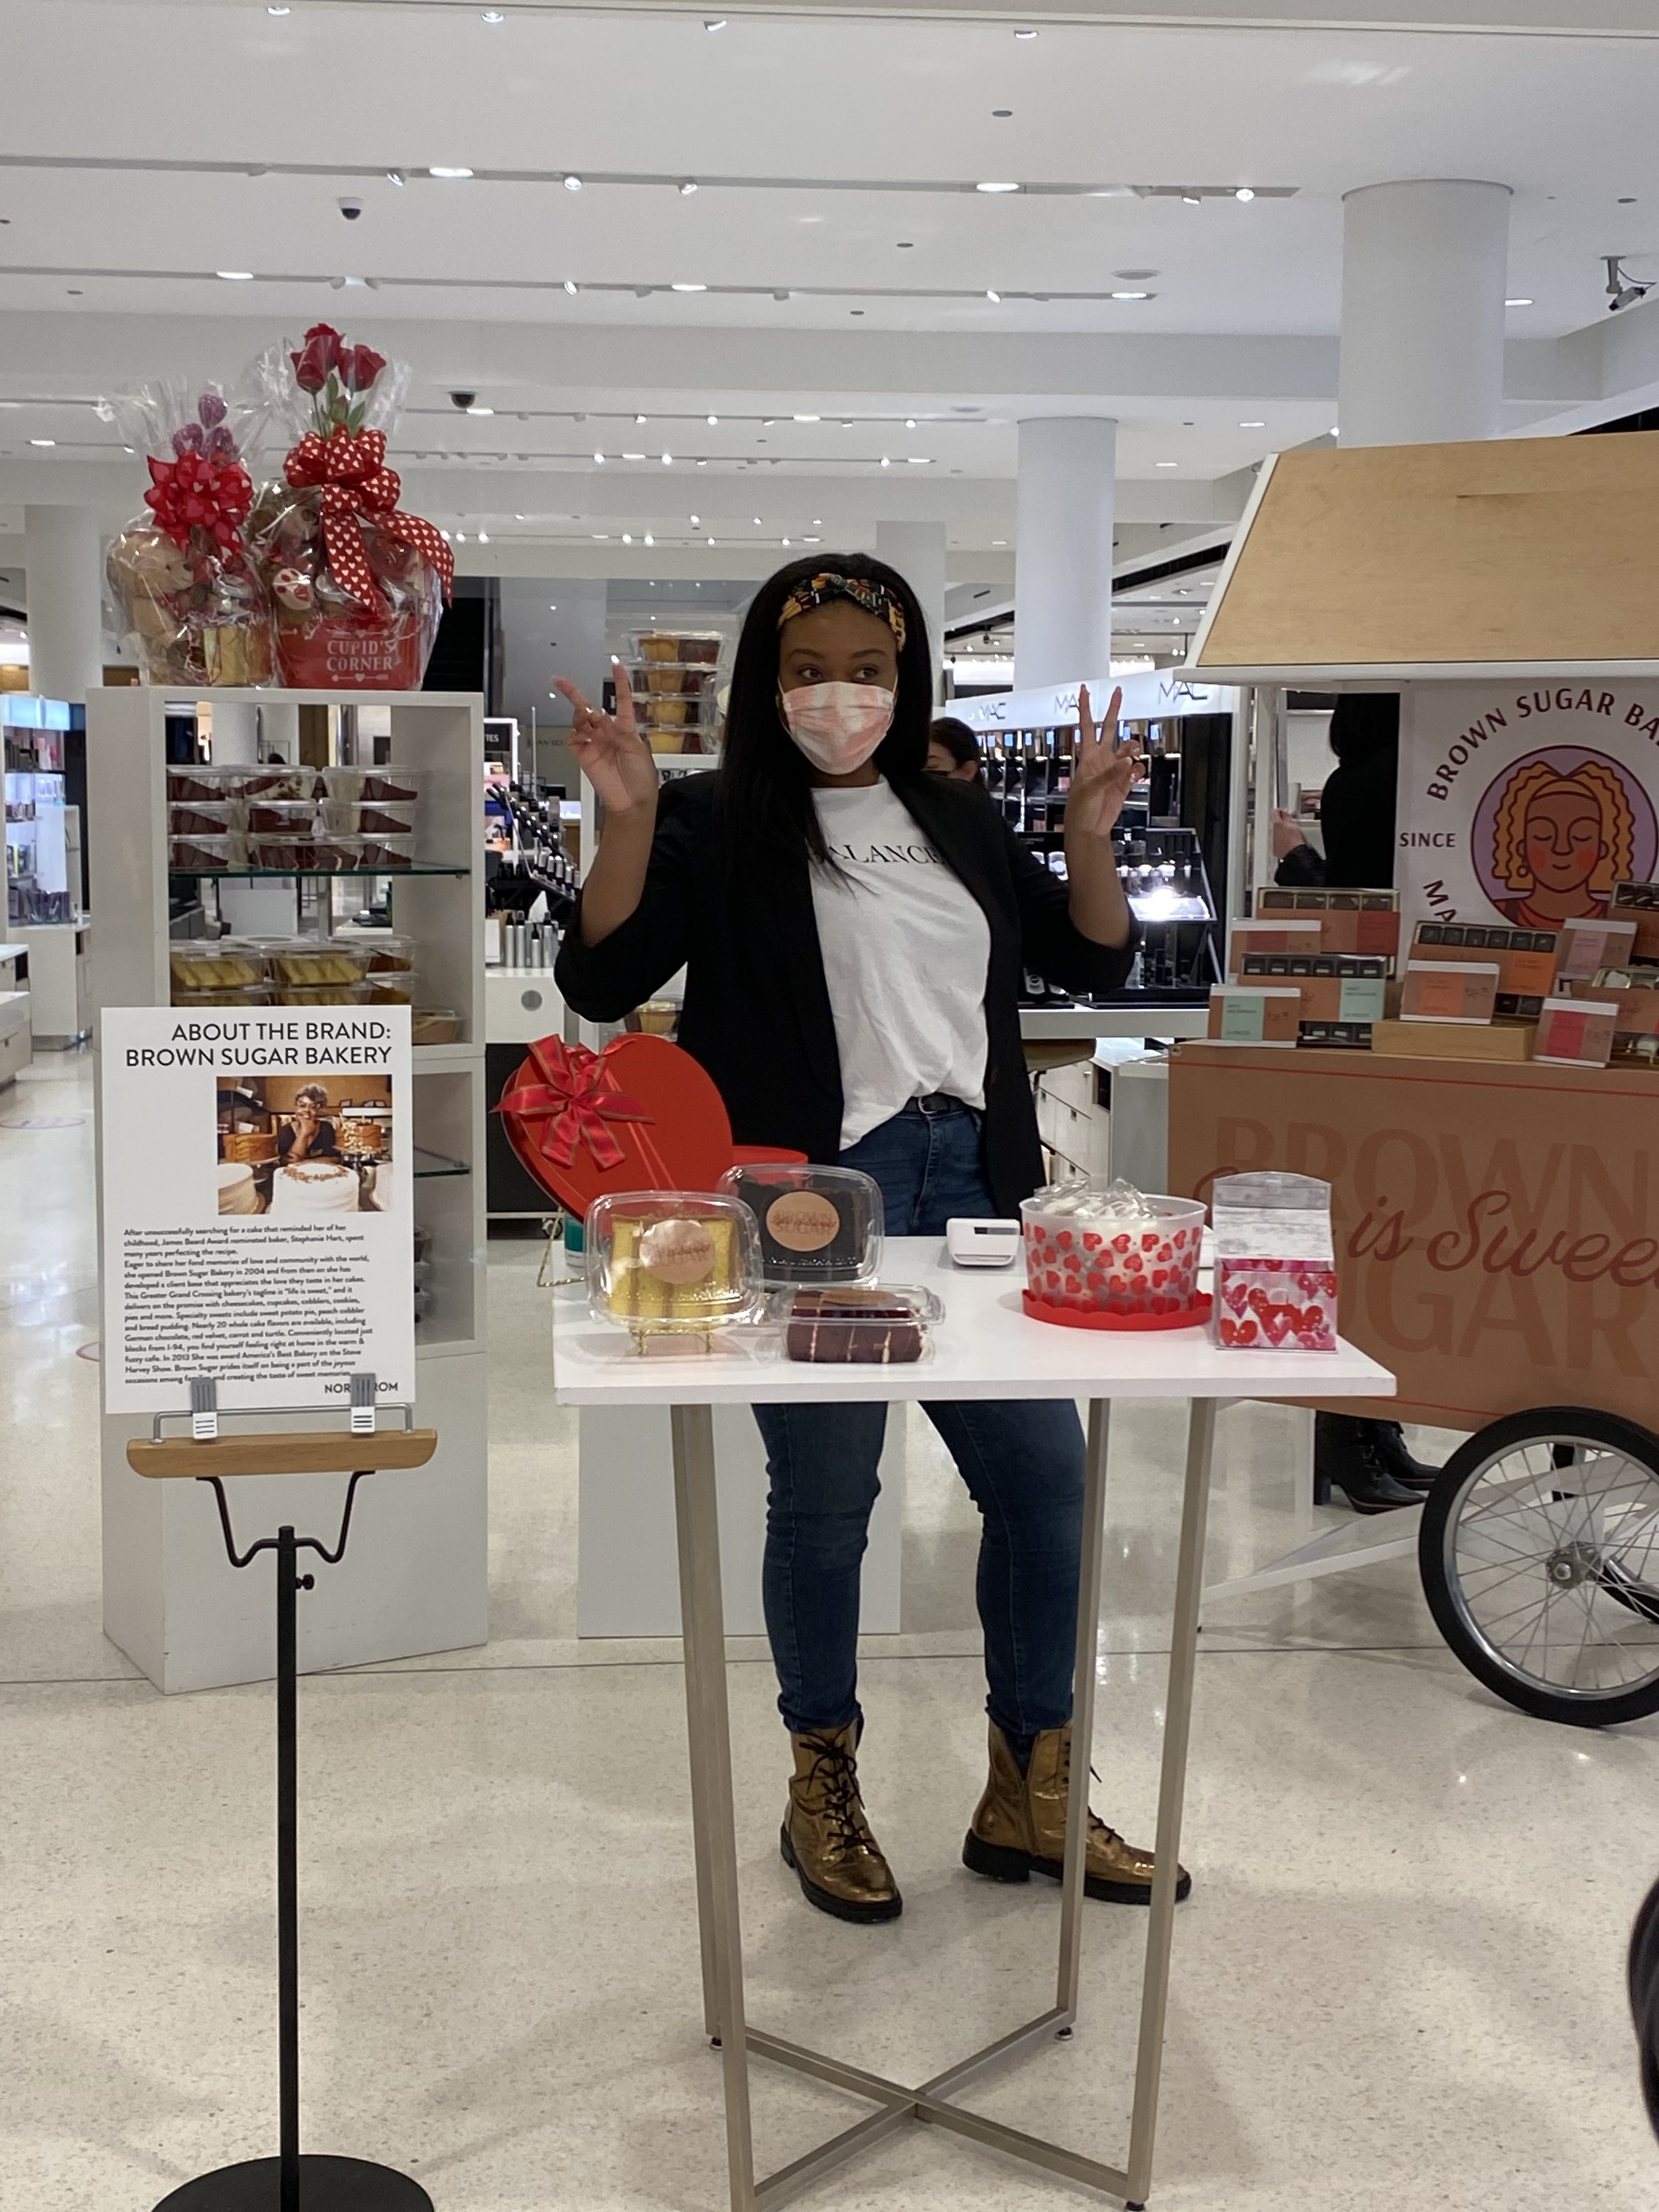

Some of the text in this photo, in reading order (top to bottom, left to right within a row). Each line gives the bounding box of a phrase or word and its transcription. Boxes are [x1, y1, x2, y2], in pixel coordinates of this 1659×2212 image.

[327, 640, 395, 654] CUPID'S
[326, 656, 393, 671] CORNER
[1055, 694, 1079, 714] MA
[1427, 688, 1659, 800] BROWN SUGAR BA
[1399, 832, 1457, 848] SINCE
[172, 1022, 391, 1041] ABOUT THE BRAND:
[127, 1047, 392, 1067] BROWN SUGAR BAKERY
[1348, 1191, 1659, 1288] is Swee
[188, 1270, 208, 1278] Sugar
[210, 1269, 234, 1278] Bakery
[294, 1350, 317, 1359] Bakery
[198, 1364, 218, 1373] Sugar
[325, 1382, 397, 1393] NOROM
